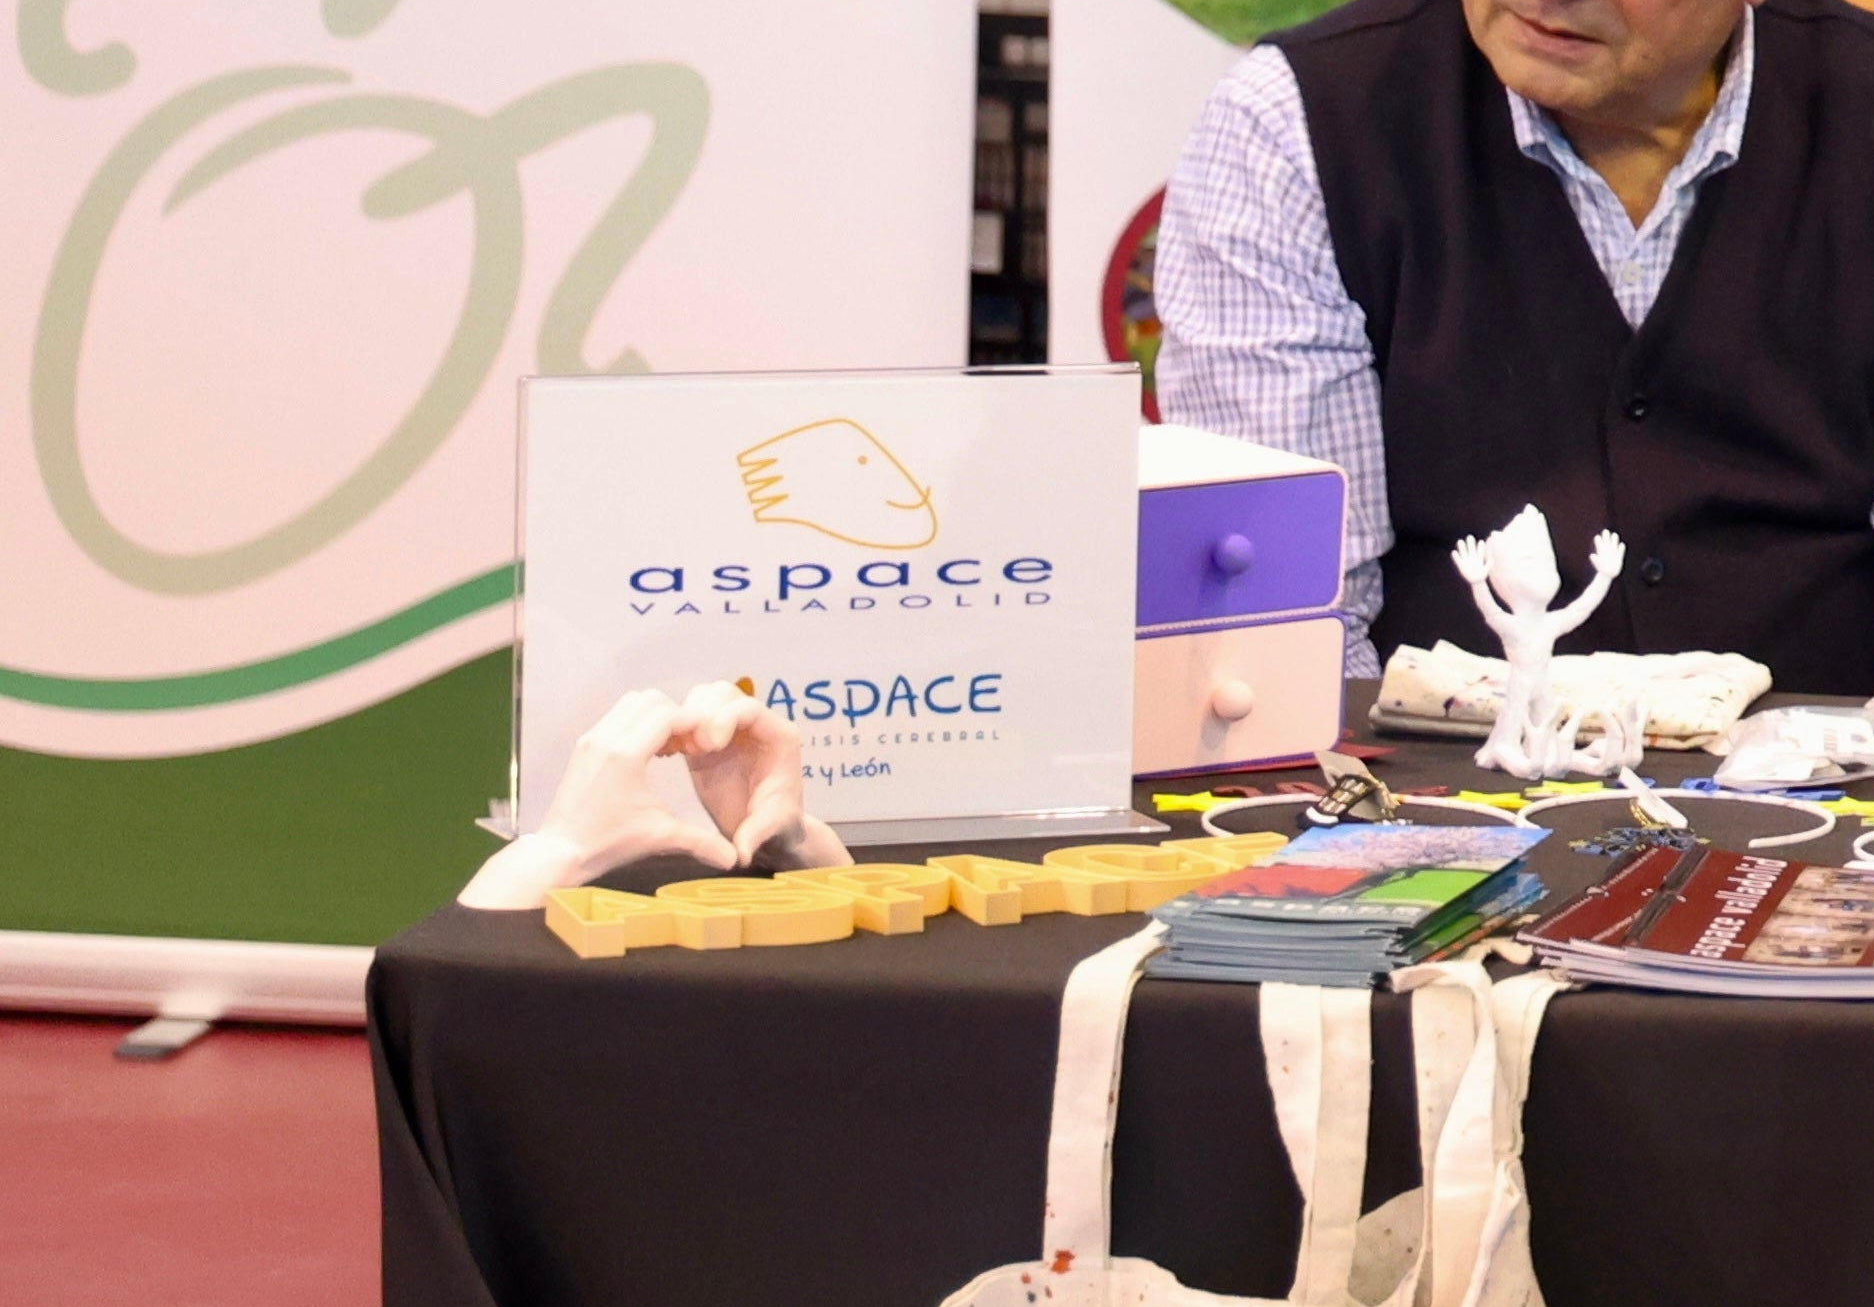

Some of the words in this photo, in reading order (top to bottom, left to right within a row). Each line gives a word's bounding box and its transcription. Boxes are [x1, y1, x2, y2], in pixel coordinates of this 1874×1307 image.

[629, 557, 1053, 601] aspace
[630, 592, 1051, 615] VALLADOLID
[766, 674, 1002, 727] ASPACE
[800, 734, 861, 747] ISIS
[878, 730, 1000, 745] CEREBRAL
[820, 766, 834, 786] y
[841, 757, 892, 778] León
